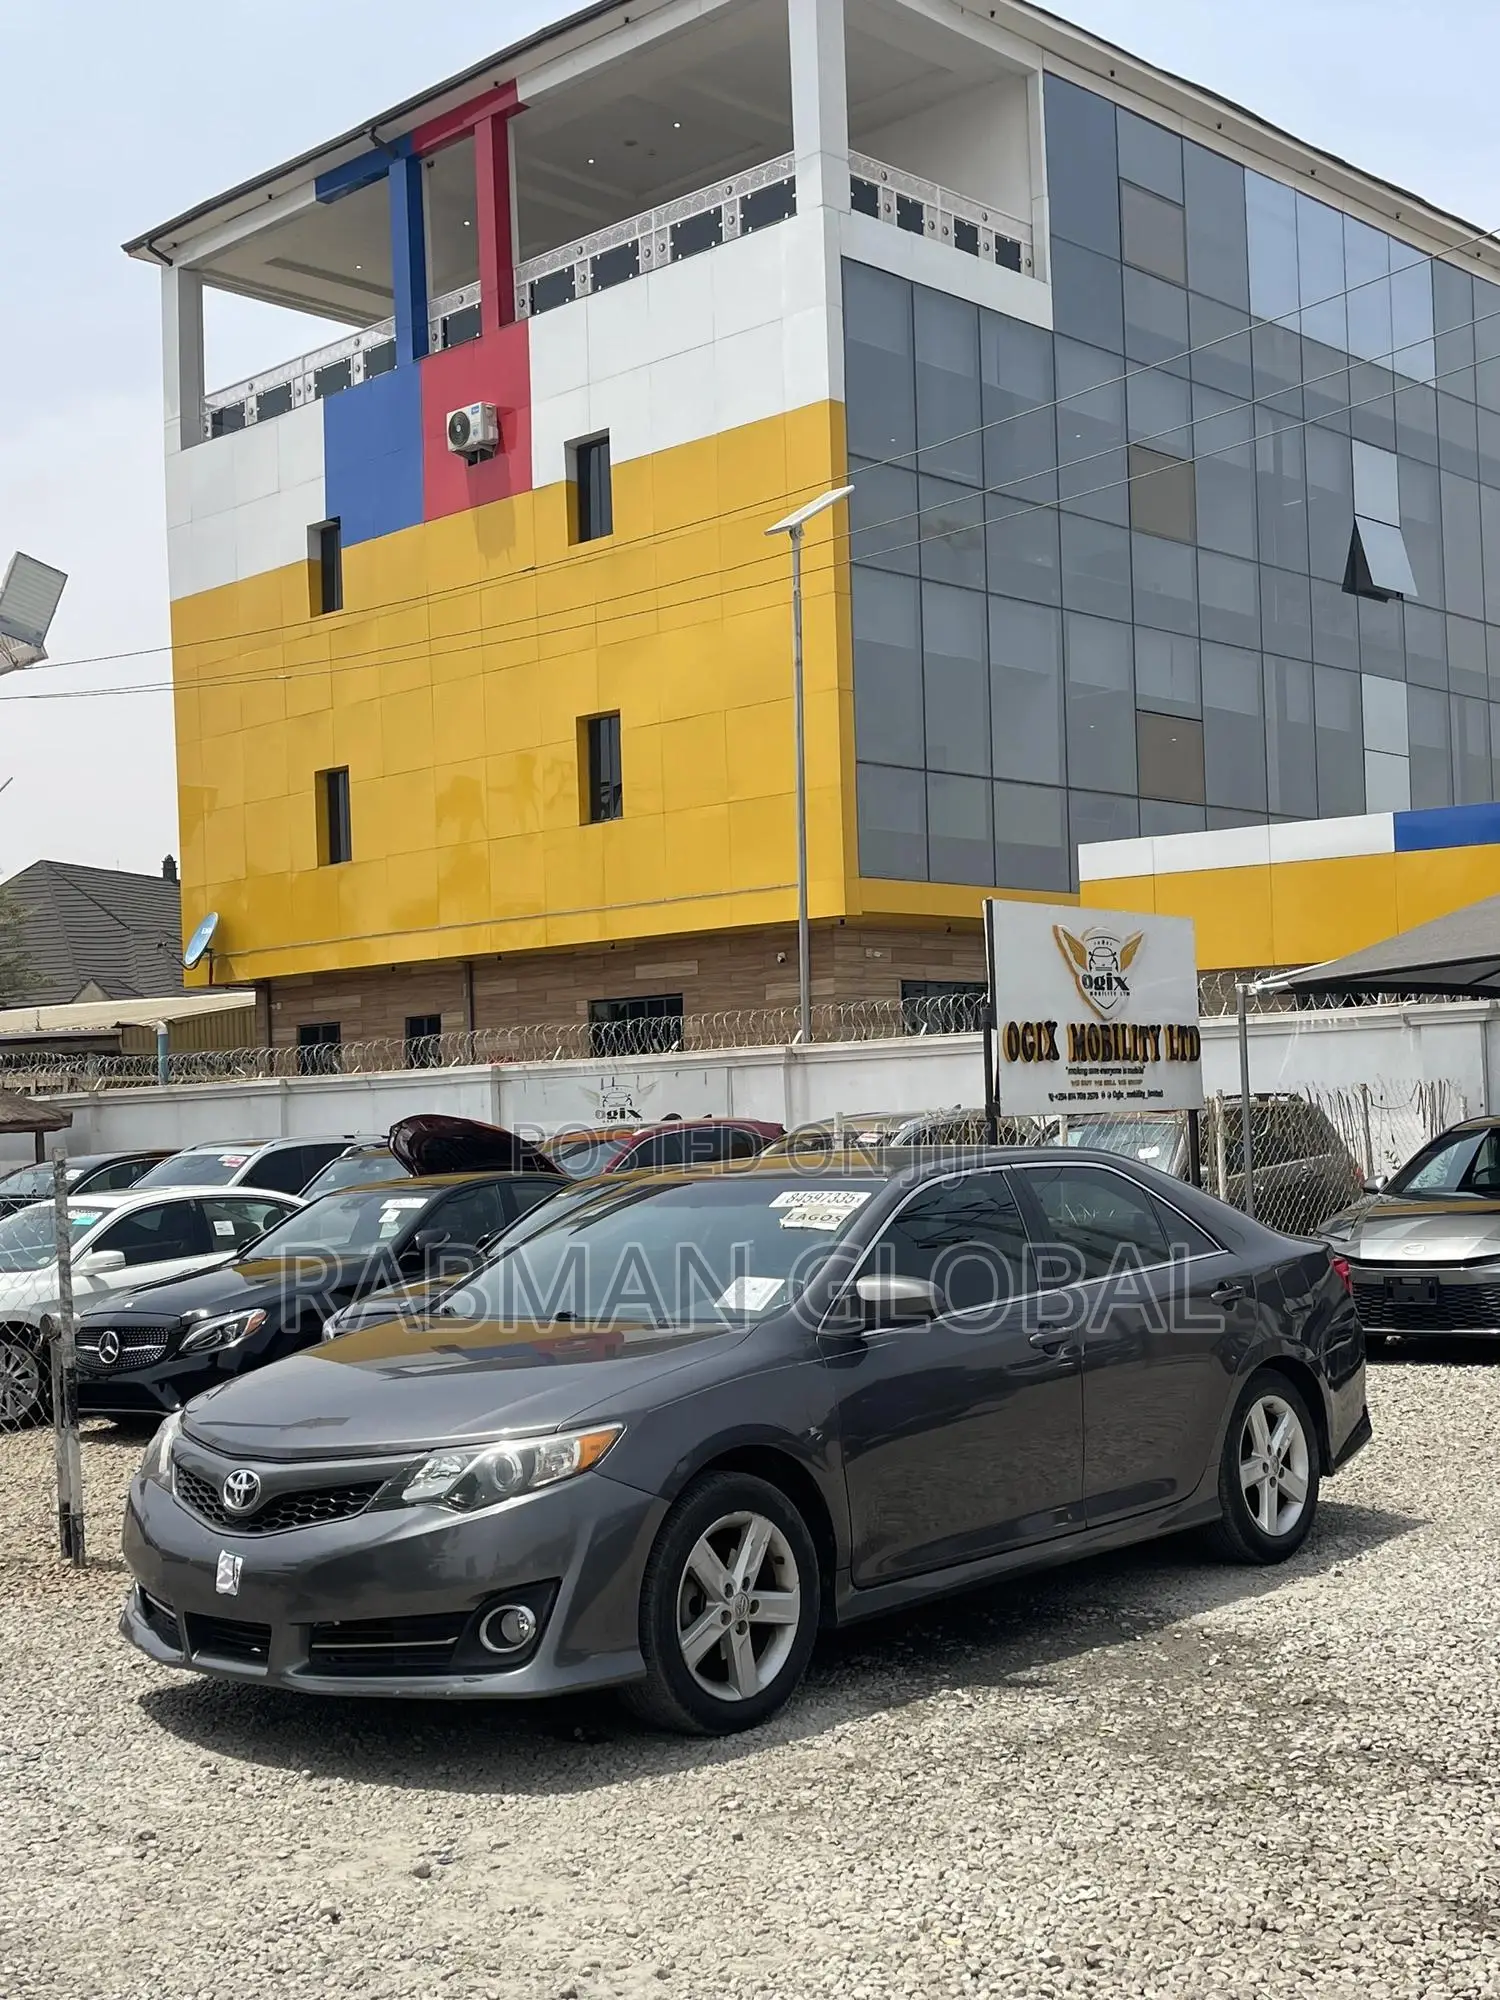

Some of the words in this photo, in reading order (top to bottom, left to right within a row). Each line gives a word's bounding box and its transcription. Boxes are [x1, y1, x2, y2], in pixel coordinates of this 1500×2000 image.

[1003, 1020, 1060, 1063] OGIX
[1067, 1023, 1162, 1063] MOBILITY
[1163, 1023, 1201, 1063] LTD
[786, 1213, 842, 1222] LAGOS
